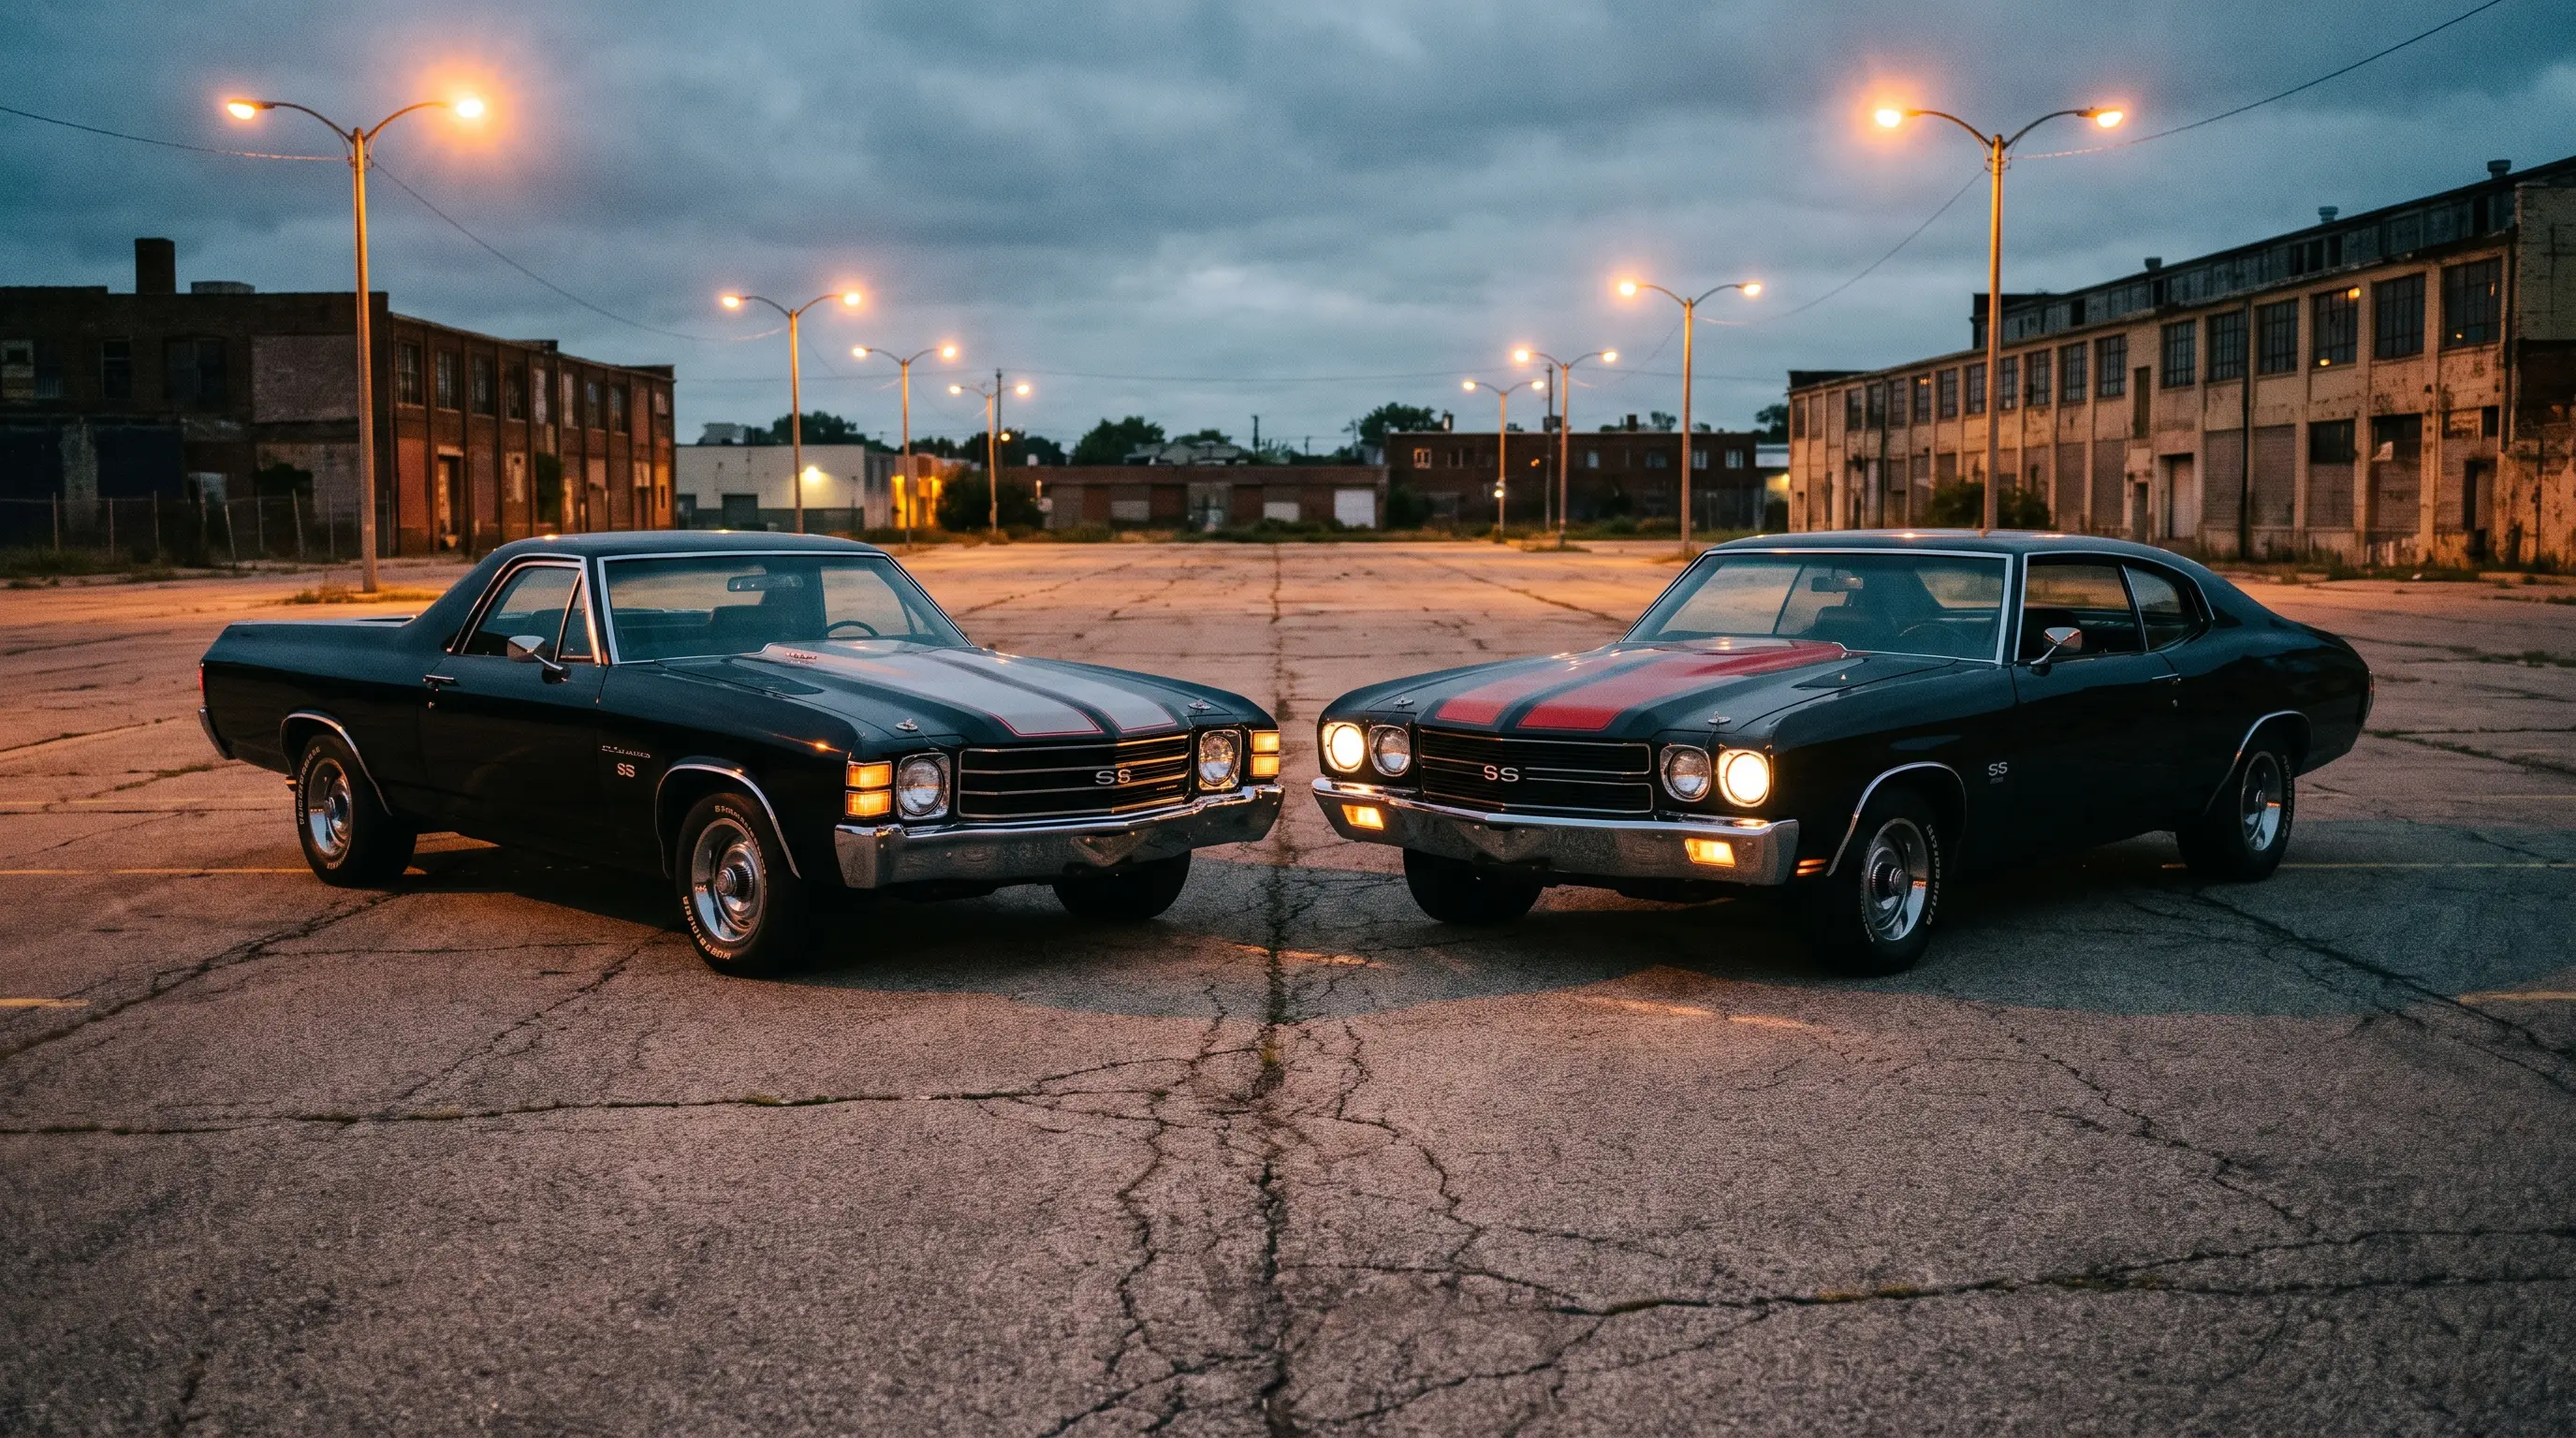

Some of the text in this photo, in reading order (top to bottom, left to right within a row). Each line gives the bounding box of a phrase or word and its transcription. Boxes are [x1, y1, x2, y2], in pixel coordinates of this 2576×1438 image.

[618, 763, 636, 778] SS
[1484, 765, 1519, 783] SS
[1988, 762, 2008, 776] SS
[1095, 769, 1132, 785] SS
